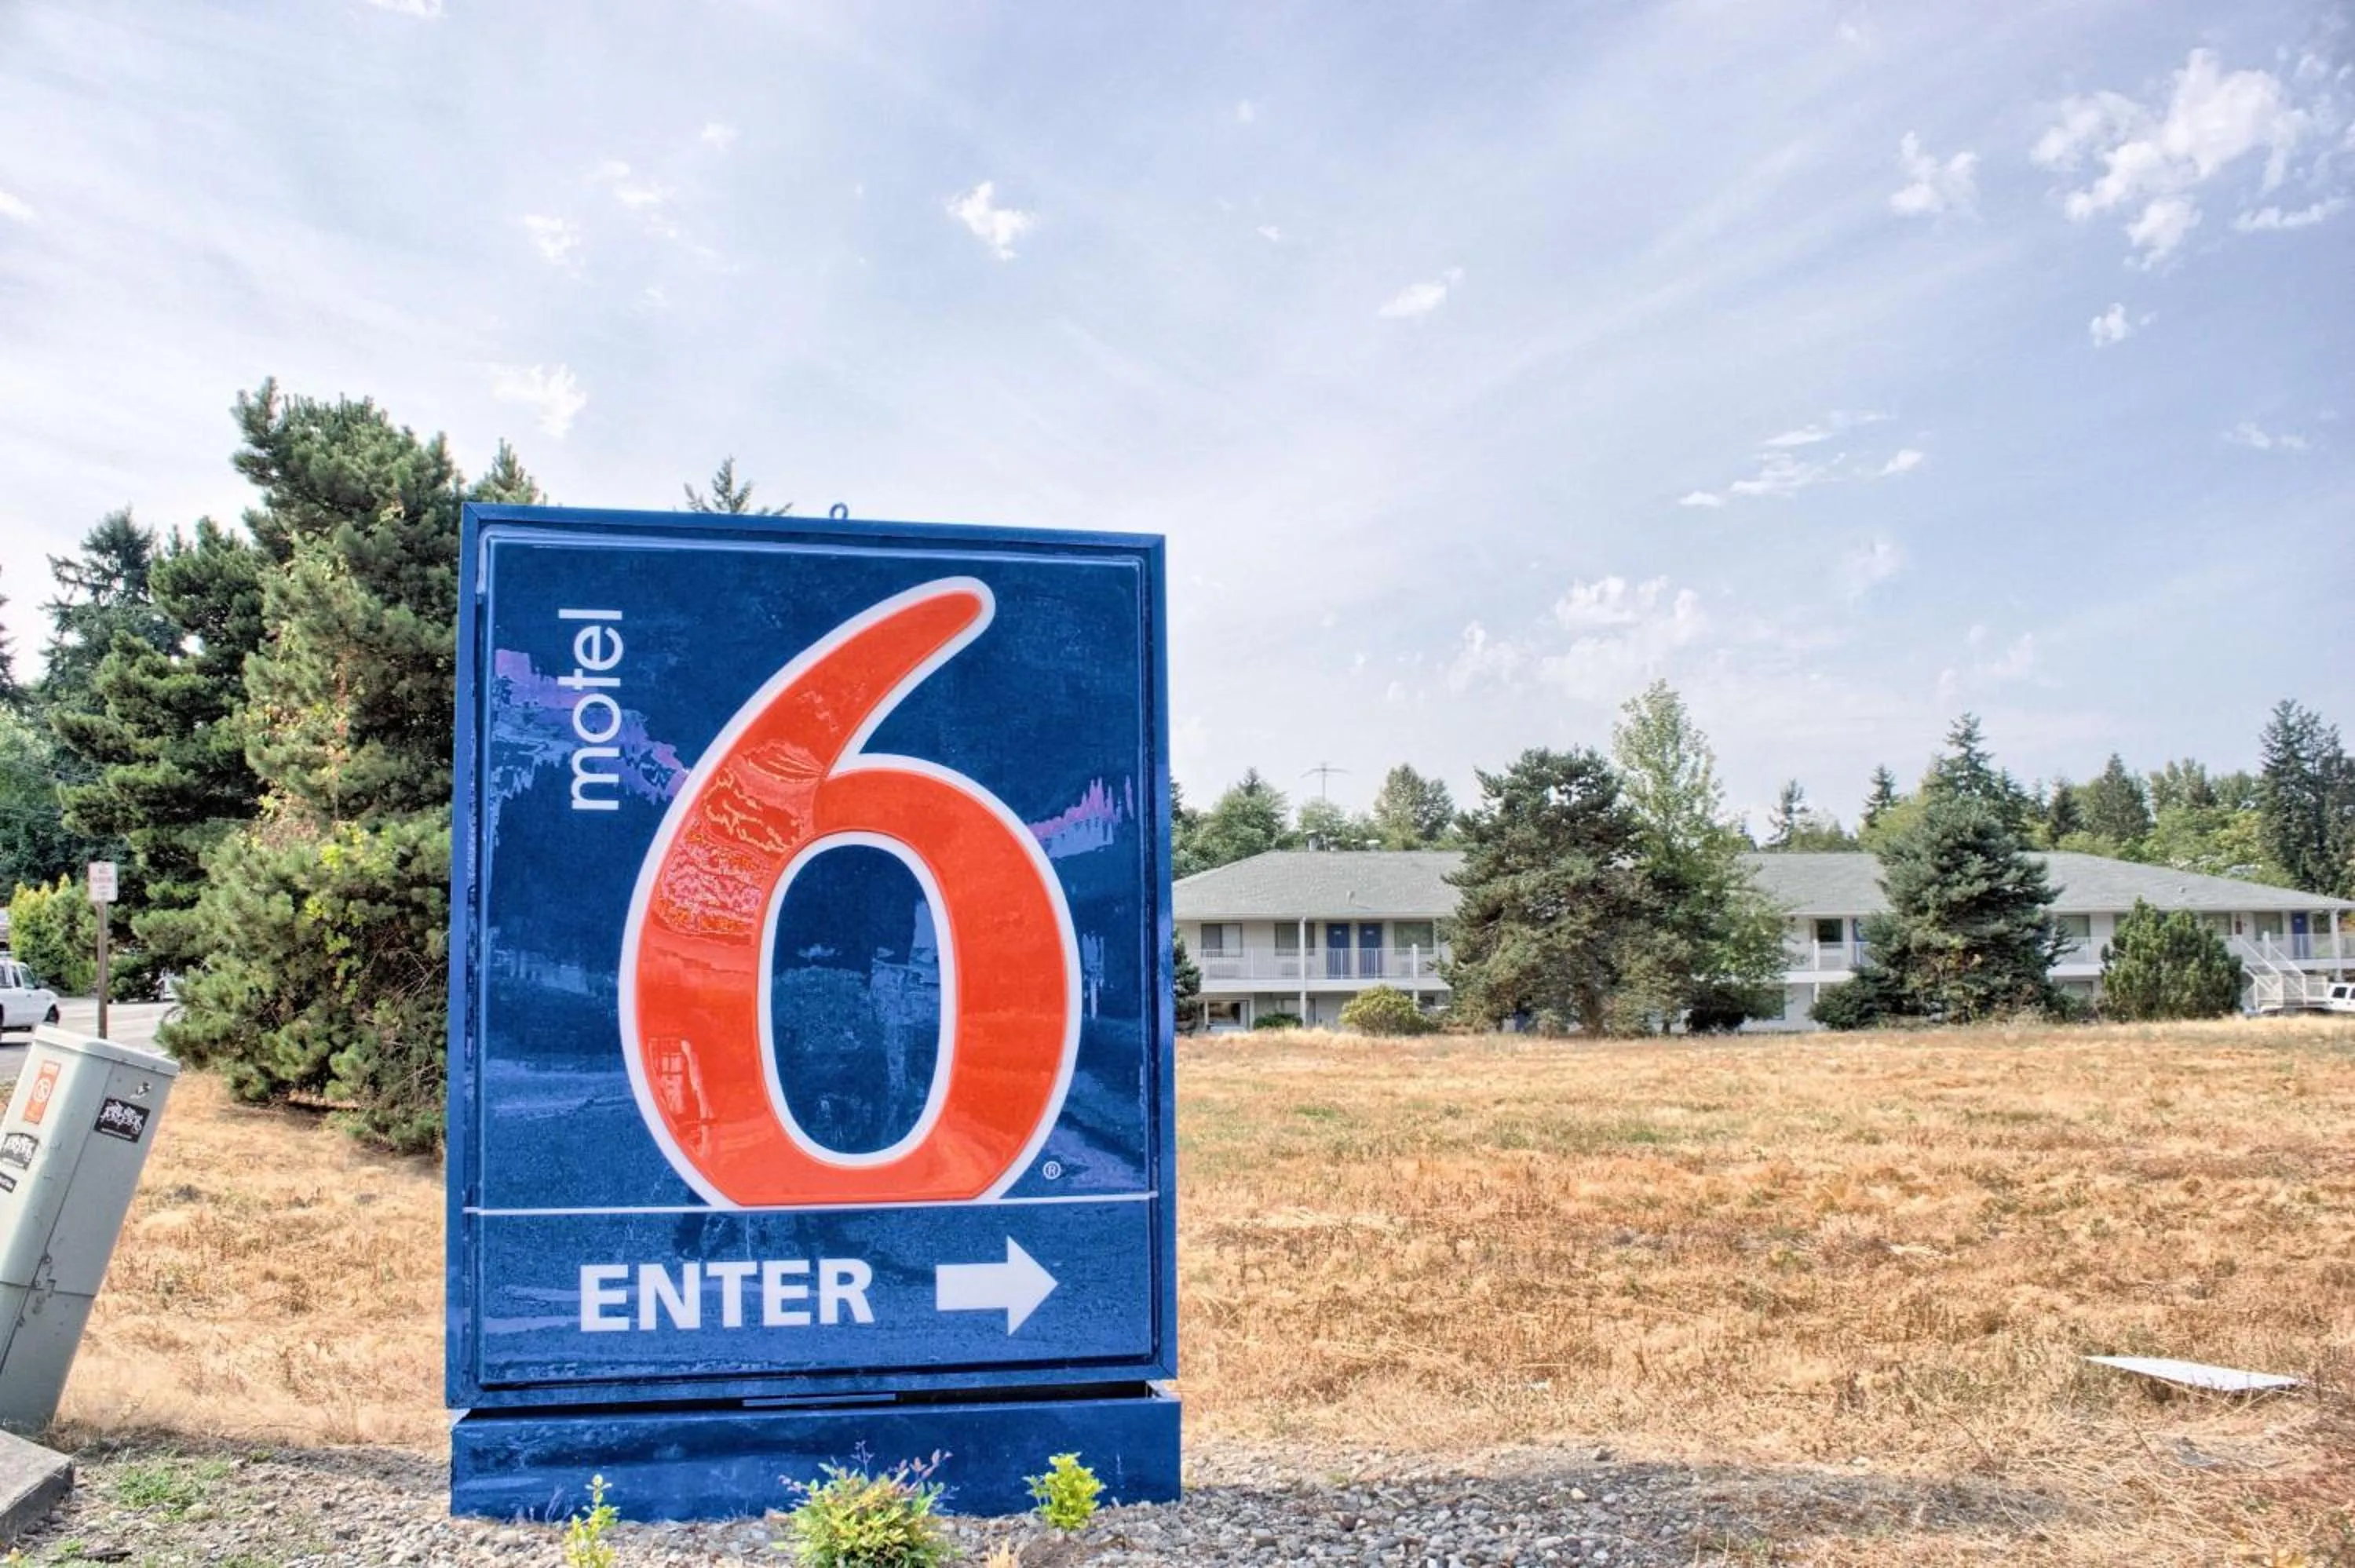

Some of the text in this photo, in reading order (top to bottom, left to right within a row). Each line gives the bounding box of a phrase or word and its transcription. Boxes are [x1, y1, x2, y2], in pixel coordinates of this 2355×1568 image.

[557, 609, 623, 810] motel
[619, 576, 1082, 1207] 6
[579, 1258, 874, 1332] ENTER
